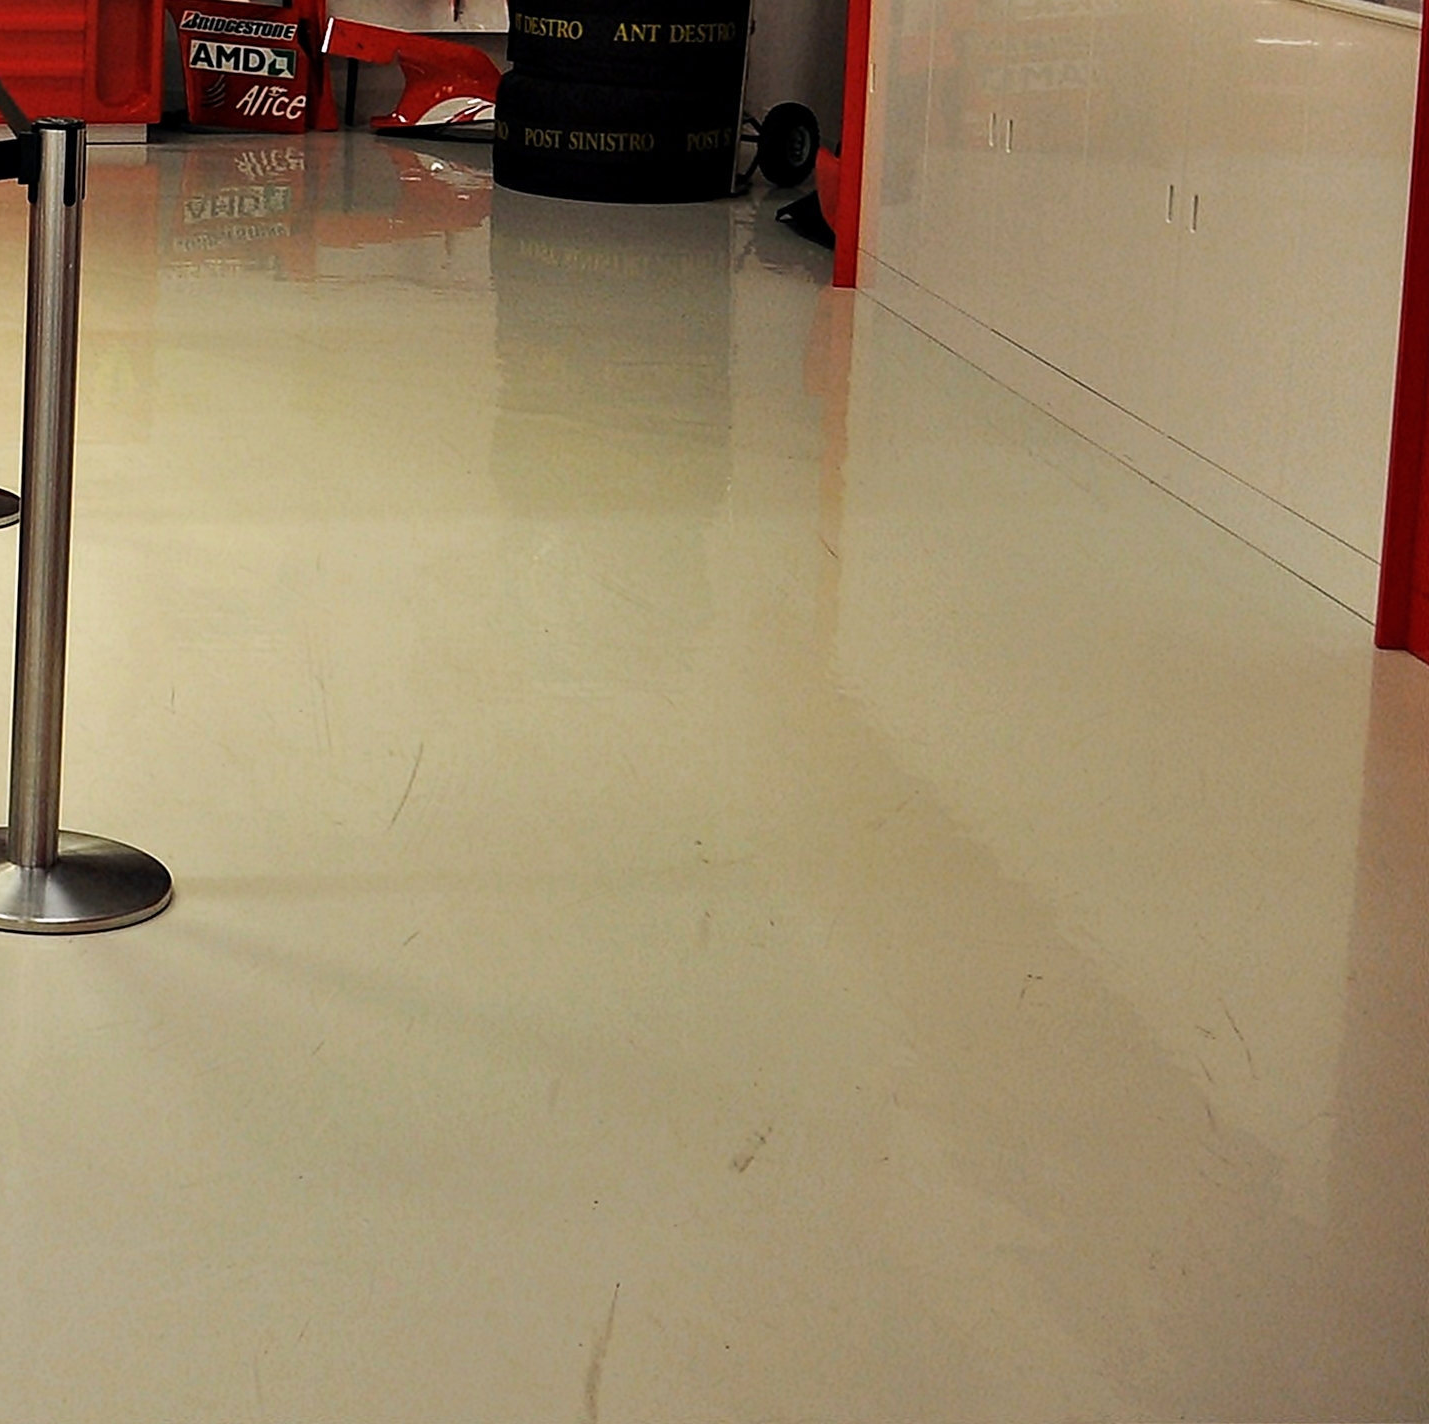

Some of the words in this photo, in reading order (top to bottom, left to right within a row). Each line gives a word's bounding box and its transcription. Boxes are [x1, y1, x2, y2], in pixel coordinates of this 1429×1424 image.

[182, 12, 296, 39] BRIDGESTONE
[524, 14, 583, 40] DESTRO
[613, 23, 661, 42] ANT
[669, 22, 735, 43] DESTRO
[191, 43, 266, 72] AMD
[236, 85, 306, 119] Alice
[524, 128, 562, 148] POST
[568, 131, 654, 152] SINISTRO
